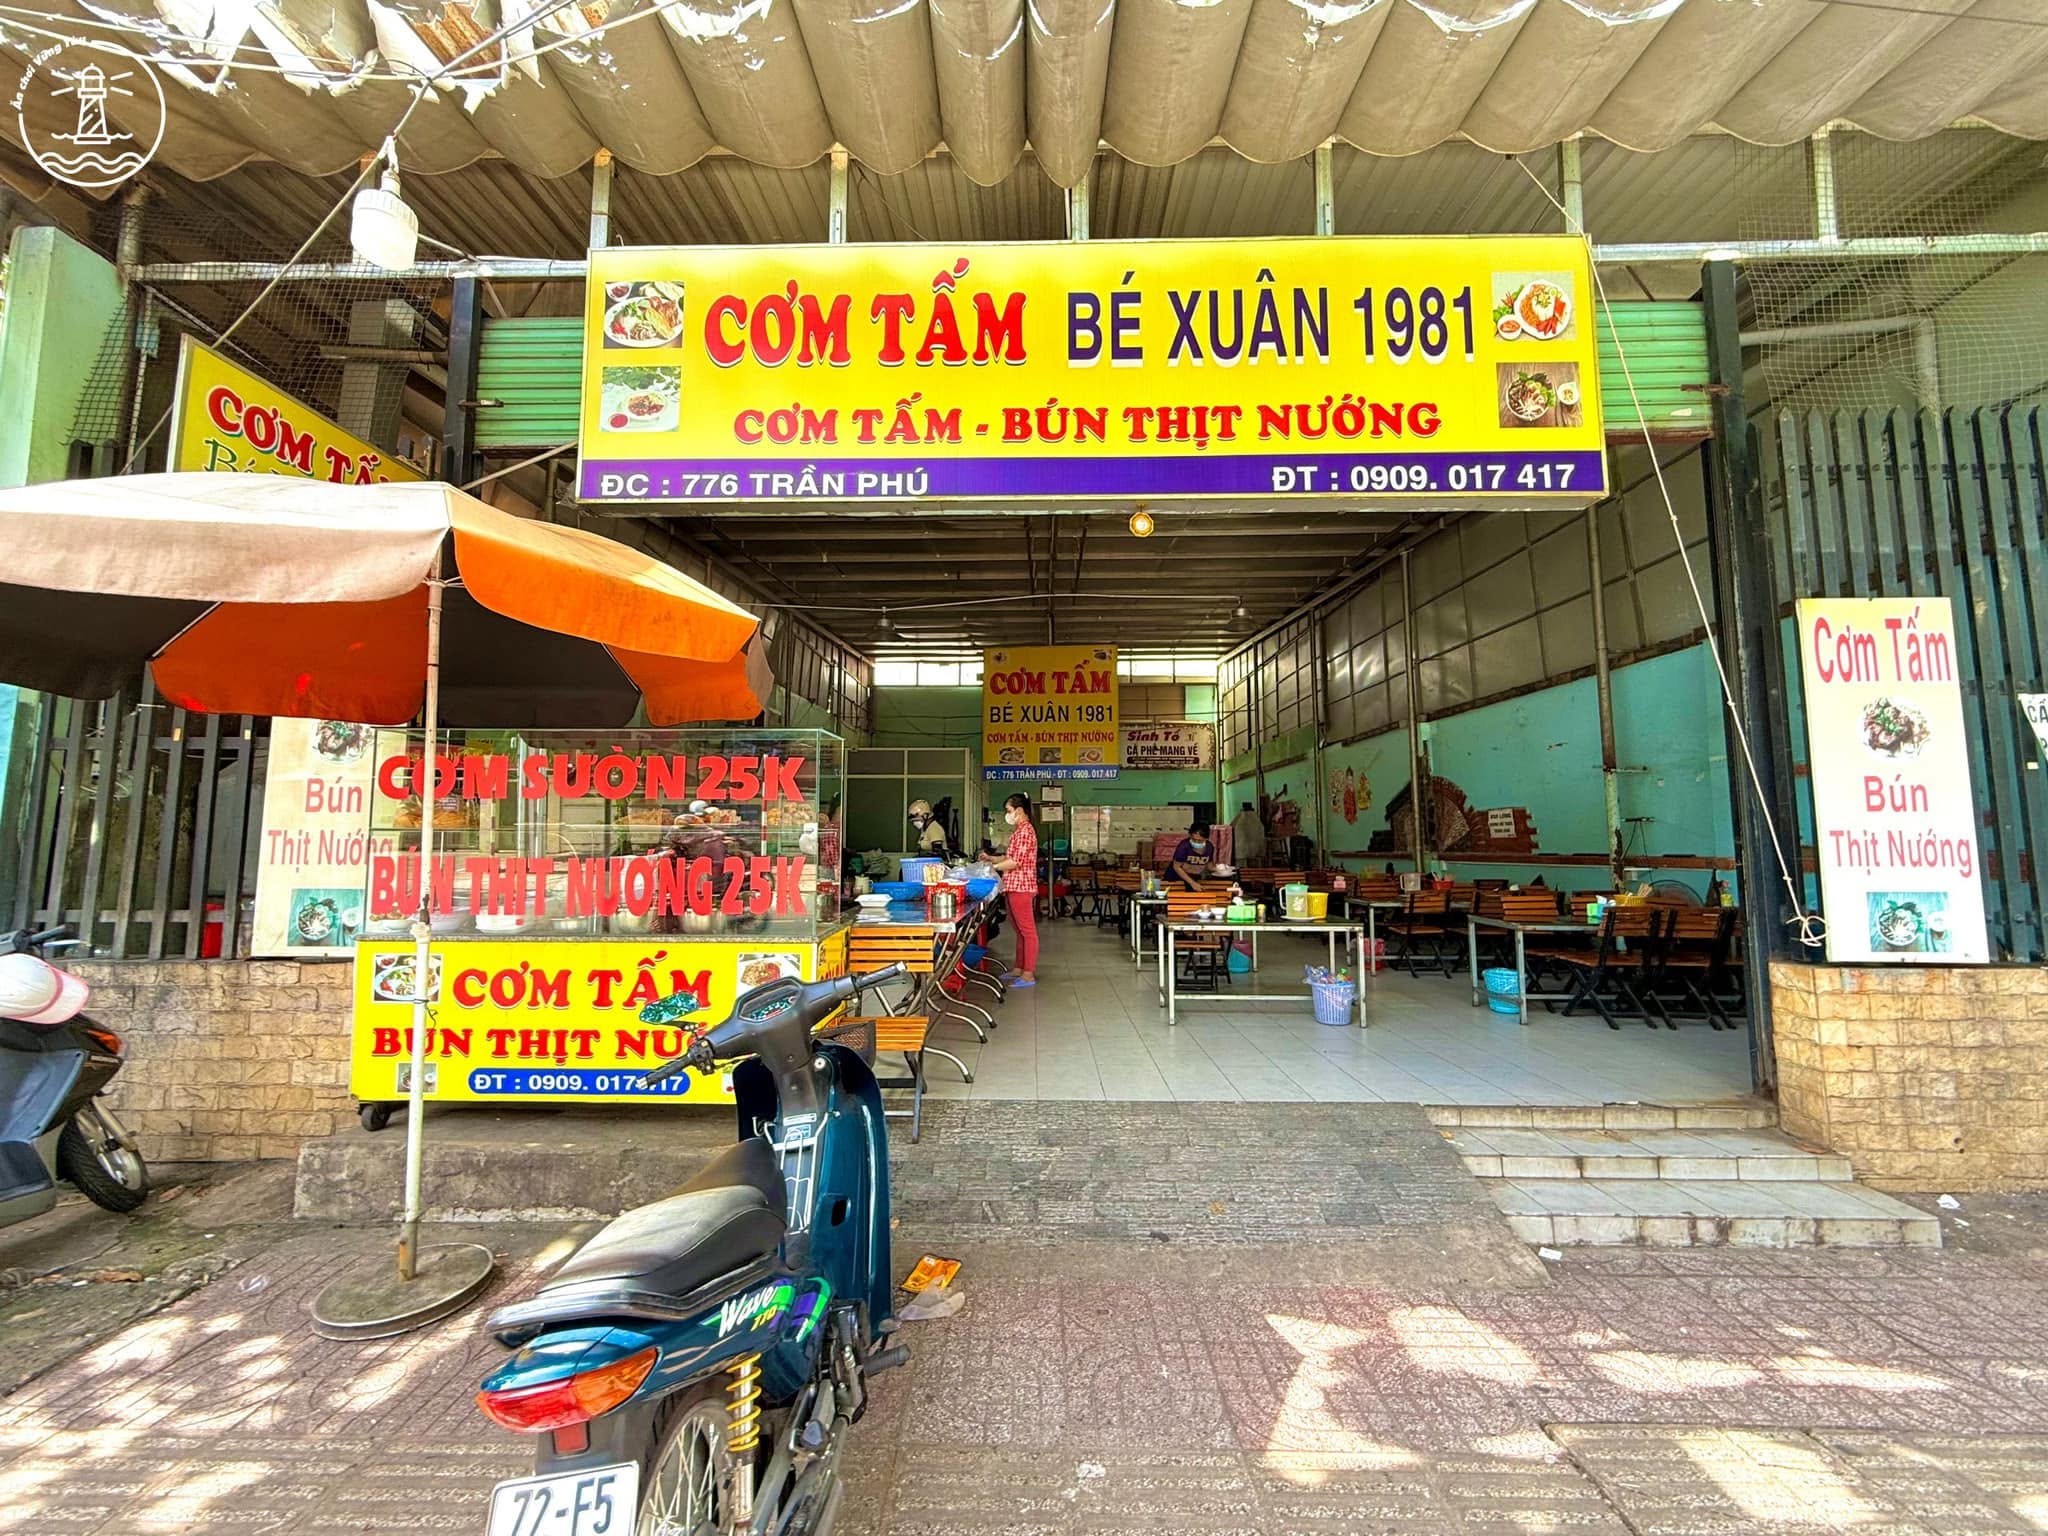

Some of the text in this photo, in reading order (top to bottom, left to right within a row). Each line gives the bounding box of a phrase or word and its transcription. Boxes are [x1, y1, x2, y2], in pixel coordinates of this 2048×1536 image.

[705, 258, 1476, 368] CƠM TẤM BÉ XUÂN 1981
[207, 386, 394, 485] CƠM TẤ
[734, 402, 838, 444] CƠM
[852, 392, 962, 444] TẤM
[1002, 397, 1108, 443] BÚN
[1123, 405, 1243, 450] THỊT
[1256, 394, 1442, 440] NƯỚNG
[204, 439, 257, 473] B
[600, 474, 650, 497] ĐC
[682, 472, 739, 496] 776
[749, 464, 845, 496] TRẦN
[858, 467, 930, 495] PHÚ
[1272, 466, 1318, 491] ĐT
[1350, 466, 1437, 490] 0909.
[1448, 465, 1511, 489] 017
[1517, 464, 1576, 488] 417
[1814, 606, 1951, 683] Cơm Tấm
[989, 660, 1112, 695] CƠM TẤM
[989, 700, 1113, 723] BÉ XUÂN 1981
[1008, 729, 1028, 743] TẤM
[1036, 730, 1055, 742] BÚN
[1057, 732, 1078, 744] THỊT
[1127, 728, 1181, 742] Sinh Tố
[1160, 745, 1185, 755] MANG
[378, 746, 806, 801] CƠM SƯỜN 25K
[304, 776, 363, 813] Bún
[1863, 774, 1929, 812] Bún
[267, 829, 310, 873] Thịt
[1829, 828, 1972, 878] Thịt Nướng
[371, 845, 808, 925] BÚN THỊT NƯỚNG 25K
[452, 950, 713, 1009] CƠM TẤM
[487, 1029, 600, 1064] THỊT
[474, 1074, 507, 1091] ĐT
[528, 1073, 588, 1091] 0909.
[642, 1073, 684, 1091] 17
[719, 1286, 777, 1338] Wave
[511, 1474, 618, 1536] 72-F5
